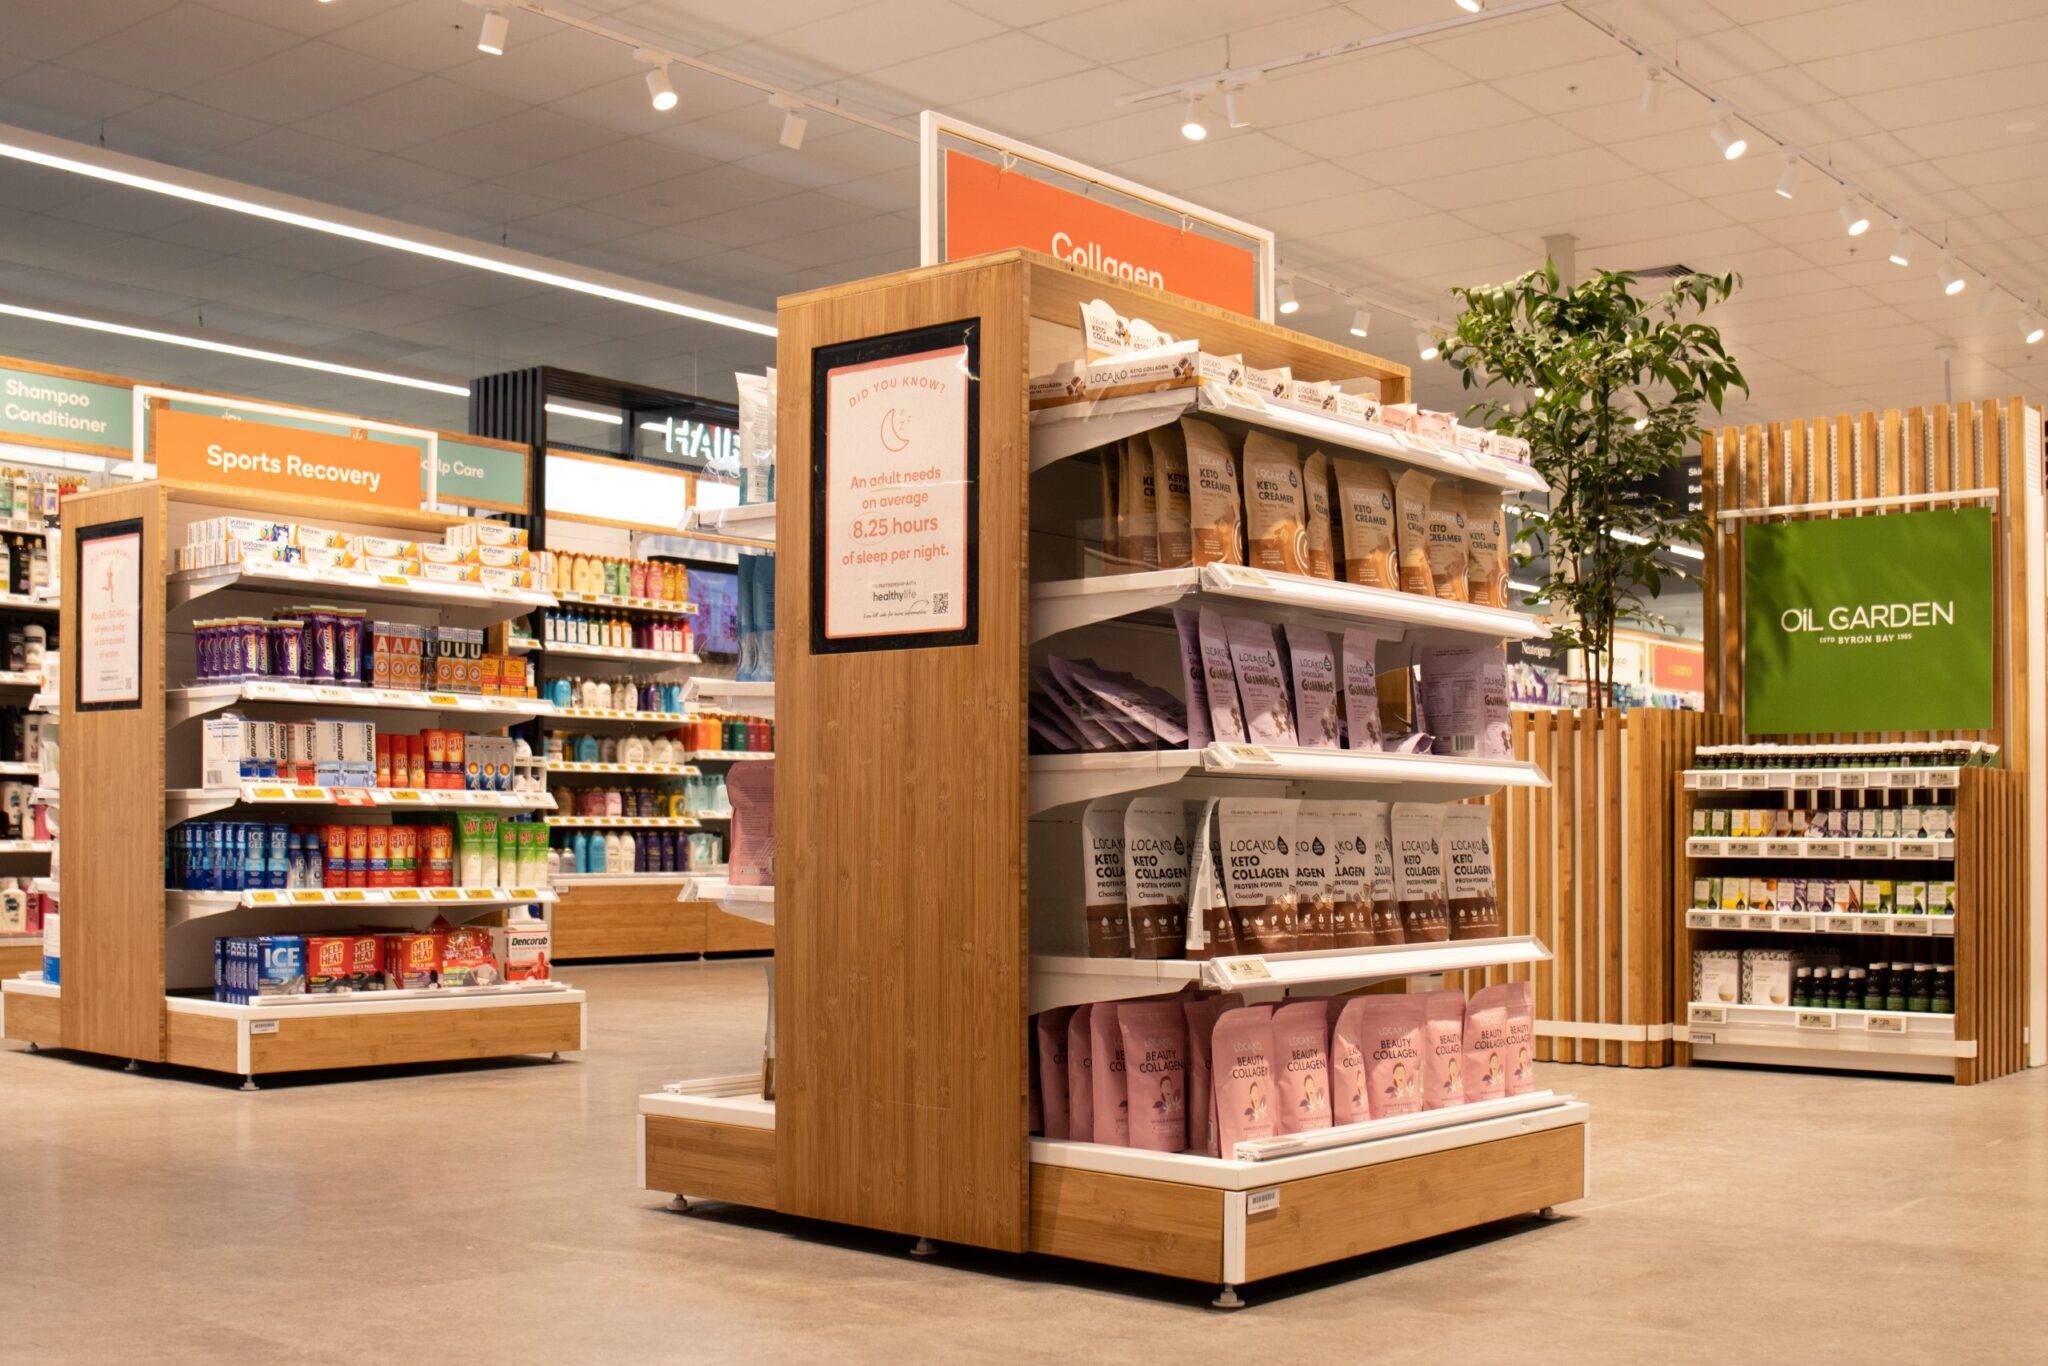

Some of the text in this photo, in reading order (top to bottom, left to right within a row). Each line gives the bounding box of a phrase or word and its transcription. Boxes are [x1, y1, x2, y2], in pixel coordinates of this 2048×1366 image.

[1051, 232, 1164, 291] Collagen
[1090, 369, 1128, 384] LOCAKO
[5, 378, 90, 408] Shampoo
[848, 376, 946, 407] DID YOU KNOW?
[4, 403, 107, 434] Conditioner
[207, 444, 381, 493] Sports Recovery
[453, 460, 485, 479] Care
[1200, 468, 1218, 480] KETO
[850, 464, 942, 489] An adult needs
[1200, 479, 1231, 494] CREAMER
[1256, 480, 1278, 491] KETO
[862, 492, 929, 510] on average
[1258, 491, 1294, 505] CREAMER
[1354, 504, 1372, 514] KETO
[1355, 514, 1387, 526] CREAMER
[853, 516, 939, 539] 8.25 hours
[1470, 532, 1486, 541] KETO
[842, 543, 949, 565] of sleep per night.
[873, 588, 917, 602] healthylife
[1828, 600, 1954, 631] GARDEN
[376, 636, 389, 651] A
[393, 637, 405, 653] A
[1838, 635, 1872, 645] BYRON
[1875, 634, 1895, 643] BAY
[441, 640, 451, 657] U
[455, 641, 466, 658] U
[471, 643, 482, 658] U
[1239, 653, 1268, 666] LOCAKO
[1300, 658, 1323, 672] LOCAKO
[365, 724, 373, 762] Dencorub
[248, 831, 264, 841] ICE
[271, 831, 287, 841] ICE
[248, 841, 263, 849] GEL
[271, 841, 287, 849] GEL
[1131, 838, 1172, 855] LOCAKO
[1230, 839, 1276, 855] LOCAKO
[1401, 841, 1431, 854] LOCAKO
[1451, 841, 1482, 854] LOCAKO
[1095, 853, 1119, 865] KETO
[1133, 855, 1158, 867] KETO
[1231, 855, 1260, 867] KETO
[1404, 855, 1421, 865] KETO
[1452, 853, 1473, 864] KETO
[1096, 867, 1125, 878] COLLA
[1135, 867, 1187, 880] COLLAGEN
[1232, 867, 1289, 880] COLLAGEN
[1296, 867, 1325, 877] AGEN
[1405, 866, 1440, 877] COLLAGEN
[1454, 865, 1491, 875] COLLAGEN
[354, 942, 375, 954] DEEP
[412, 939, 433, 951] DEEP
[511, 936, 548, 947] Dencorub
[321, 942, 344, 957] DEEP
[412, 948, 432, 961] HEAT
[264, 947, 300, 968] ICE
[321, 953, 343, 966] HEAT
[354, 951, 374, 962] HEAT
[1481, 1029, 1502, 1040] BEAUTY
[1510, 1025, 1530, 1036] BEAUTY
[1380, 1038, 1411, 1049] BEAUTY
[1146, 1050, 1176, 1062] BEAUTY
[1236, 1054, 1264, 1067] BEAUTY
[1292, 1048, 1318, 1060] BEAUTY
[1373, 1049, 1418, 1061] COLLAGEN
[1139, 1061, 1185, 1074] COLLAGEN
[1287, 1059, 1326, 1072] COLLAGEN
